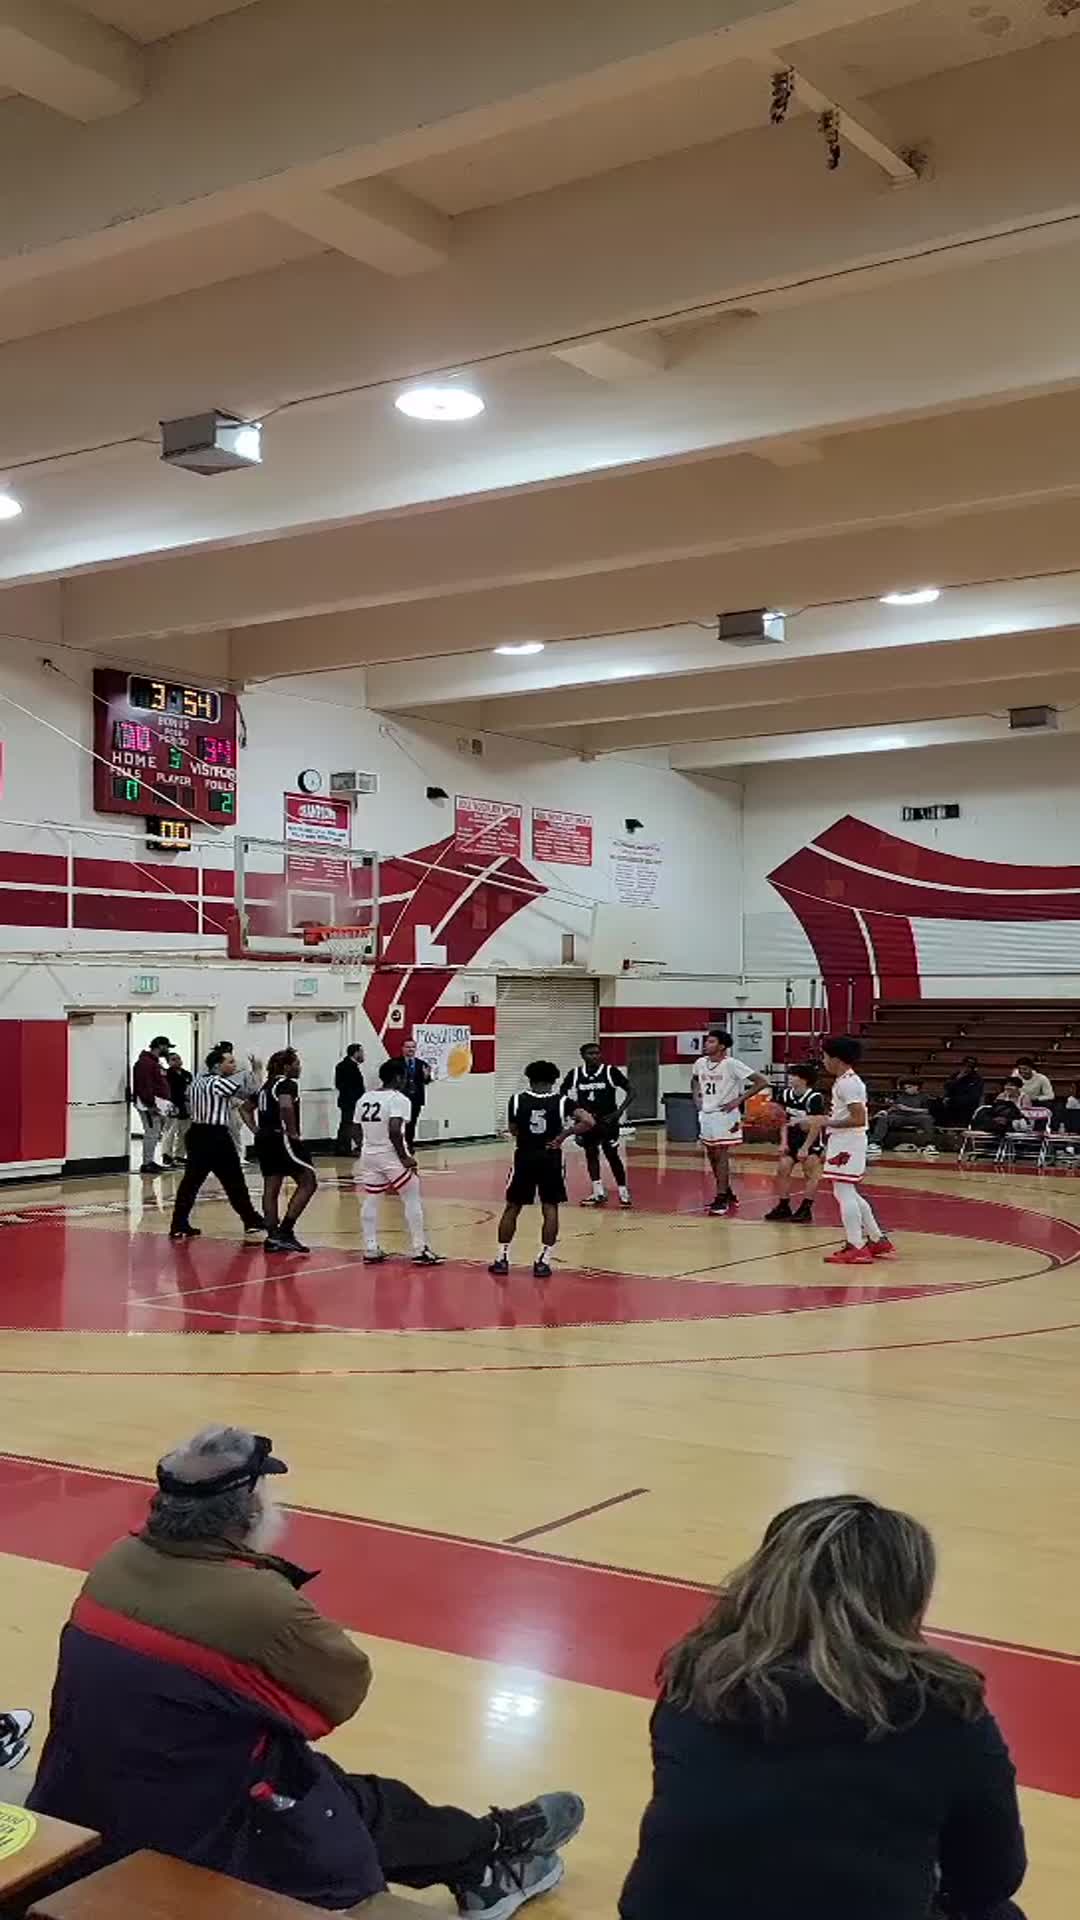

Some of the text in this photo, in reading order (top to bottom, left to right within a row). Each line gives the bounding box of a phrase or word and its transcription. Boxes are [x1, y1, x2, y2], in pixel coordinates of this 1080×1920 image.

[112, 751, 157, 768] HOME
[155, 772, 192, 787] PLAYER
[205, 779, 235, 791] FOULS
[126, 780, 138, 800] 0
[221, 793, 232, 813] 2
[705, 1083, 716, 1095] 21
[361, 1102, 382, 1122] 22
[529, 1109, 547, 1134] 5
